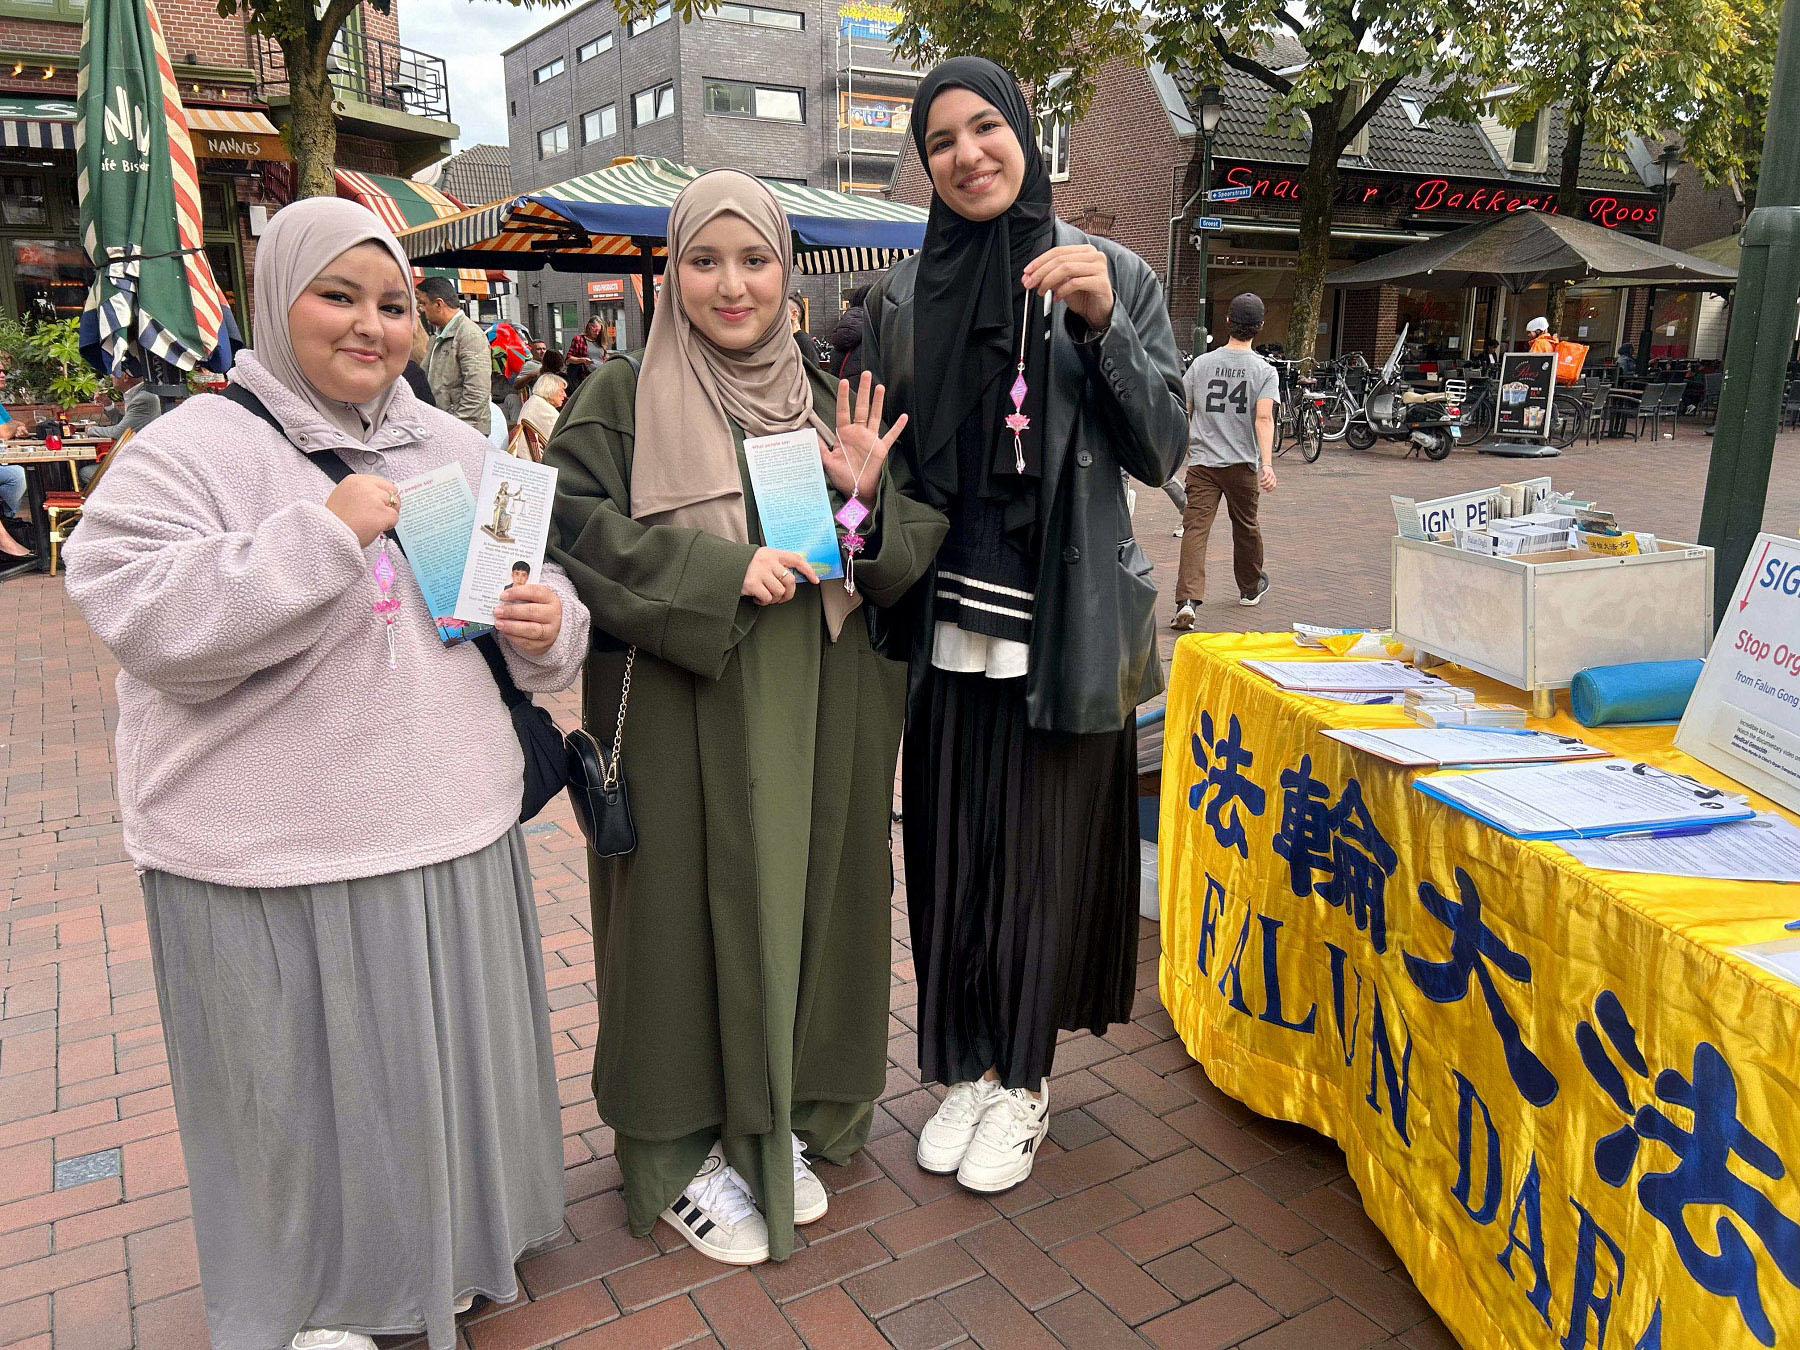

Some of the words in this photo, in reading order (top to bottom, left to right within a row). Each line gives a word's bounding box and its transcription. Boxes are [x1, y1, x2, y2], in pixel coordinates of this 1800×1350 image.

[208, 138, 260, 156] NANNES
[1217, 189, 1249, 198] Spoorstraat
[1589, 197, 1658, 229] Roos
[1215, 367, 1246, 378] RAIDERS
[1206, 379, 1248, 413] 24
[1420, 508, 1455, 533] IGN
[1760, 558, 1800, 598] SIG
[1735, 629, 1770, 662] Stop
[1735, 670, 1754, 687] from
[1754, 678, 1776, 697] Falun
[1777, 688, 1800, 708] Gong
[1197, 871, 1412, 1149] FALUN
